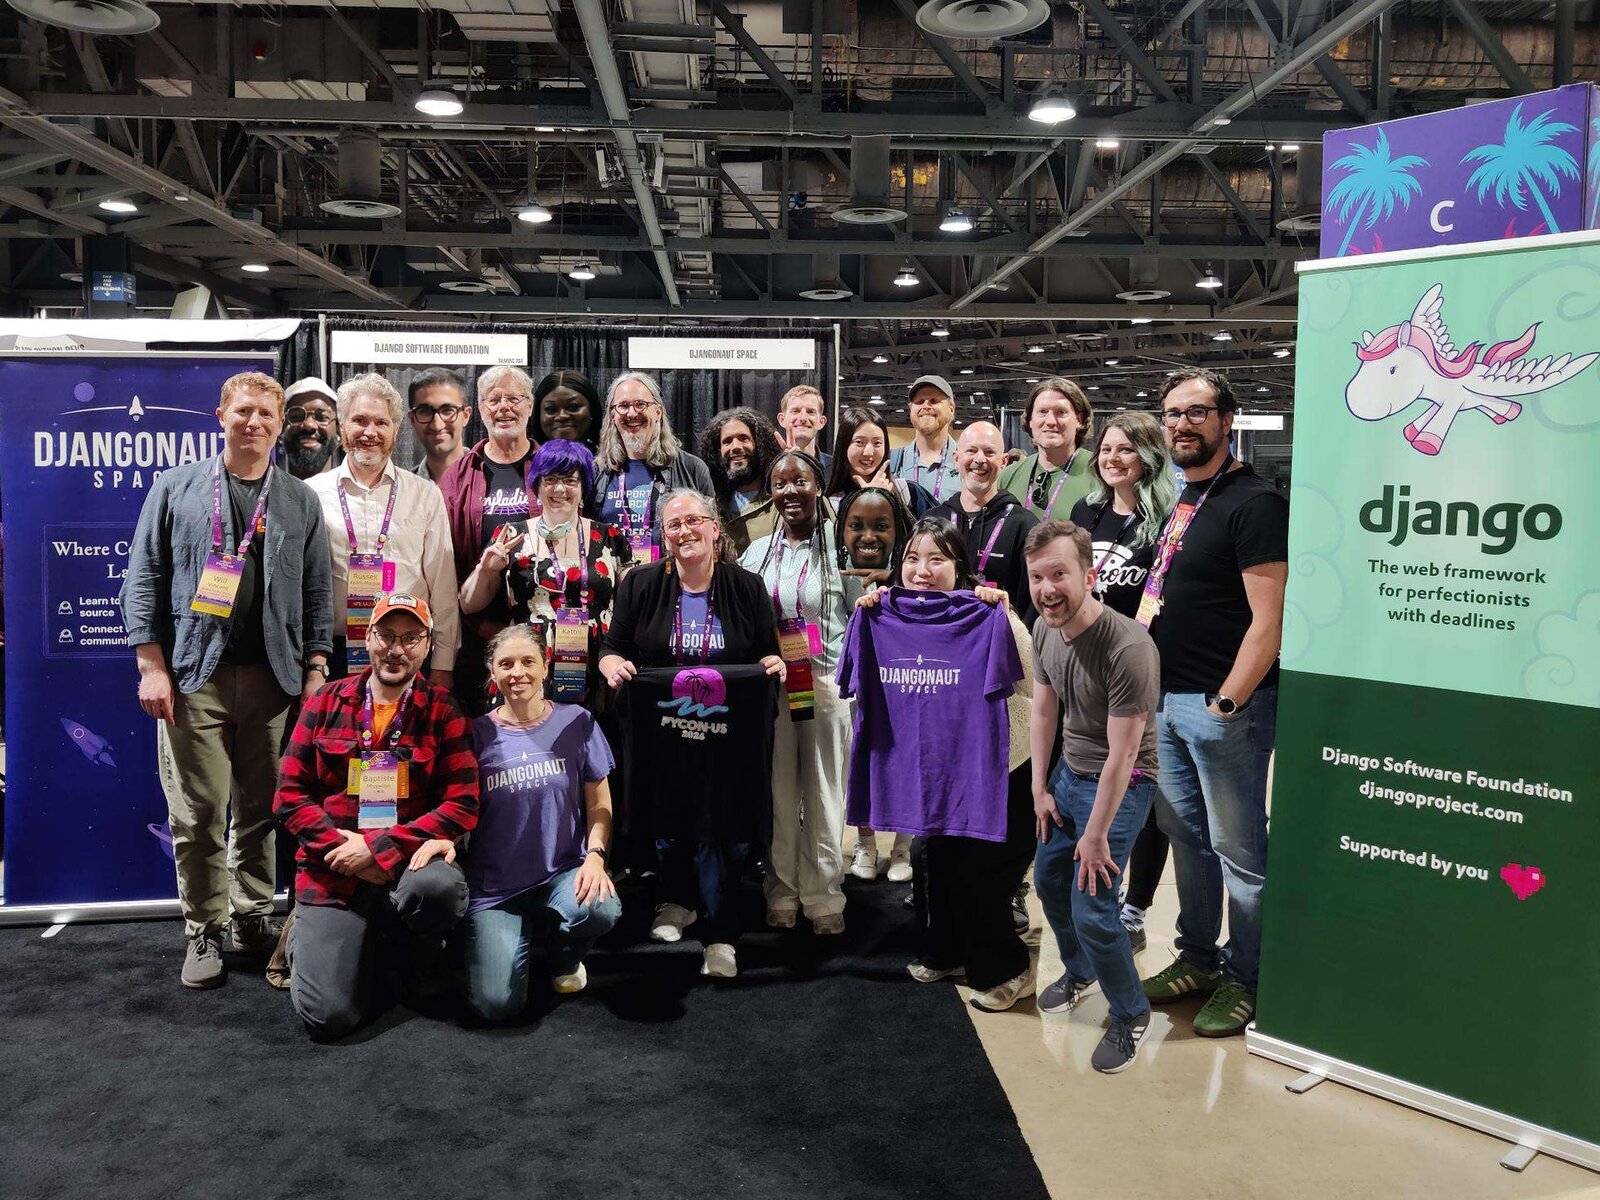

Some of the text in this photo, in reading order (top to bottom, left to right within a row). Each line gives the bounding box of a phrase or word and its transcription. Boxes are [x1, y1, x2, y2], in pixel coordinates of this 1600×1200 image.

[1430, 200, 1455, 232] C
[374, 343, 489, 354] DJANGO SOFTWARE FOUNDATION
[689, 349, 758, 359] DJANGONAUT SPACE
[94, 470, 161, 488] SPA
[608, 490, 652, 499] SUPORT
[618, 514, 644, 522] TCH
[1359, 484, 1562, 555] django
[52, 541, 110, 556] Where
[1368, 560, 1546, 584] The web framework
[80, 597, 108, 605] Learn
[1379, 583, 1530, 607] for perfectionists
[1388, 608, 1516, 631] with deadlines
[80, 625, 123, 633] Connect
[879, 667, 960, 685] DJANGONAUT
[901, 685, 937, 694] SPACE
[682, 730, 705, 740] 2026
[487, 758, 567, 792] DJANGONAUT
[1322, 746, 1573, 802] Django Software Foundation
[510, 777, 548, 793] SPACE
[1359, 780, 1523, 824] djangoproject.com
[1340, 835, 1488, 881] Supported by you
